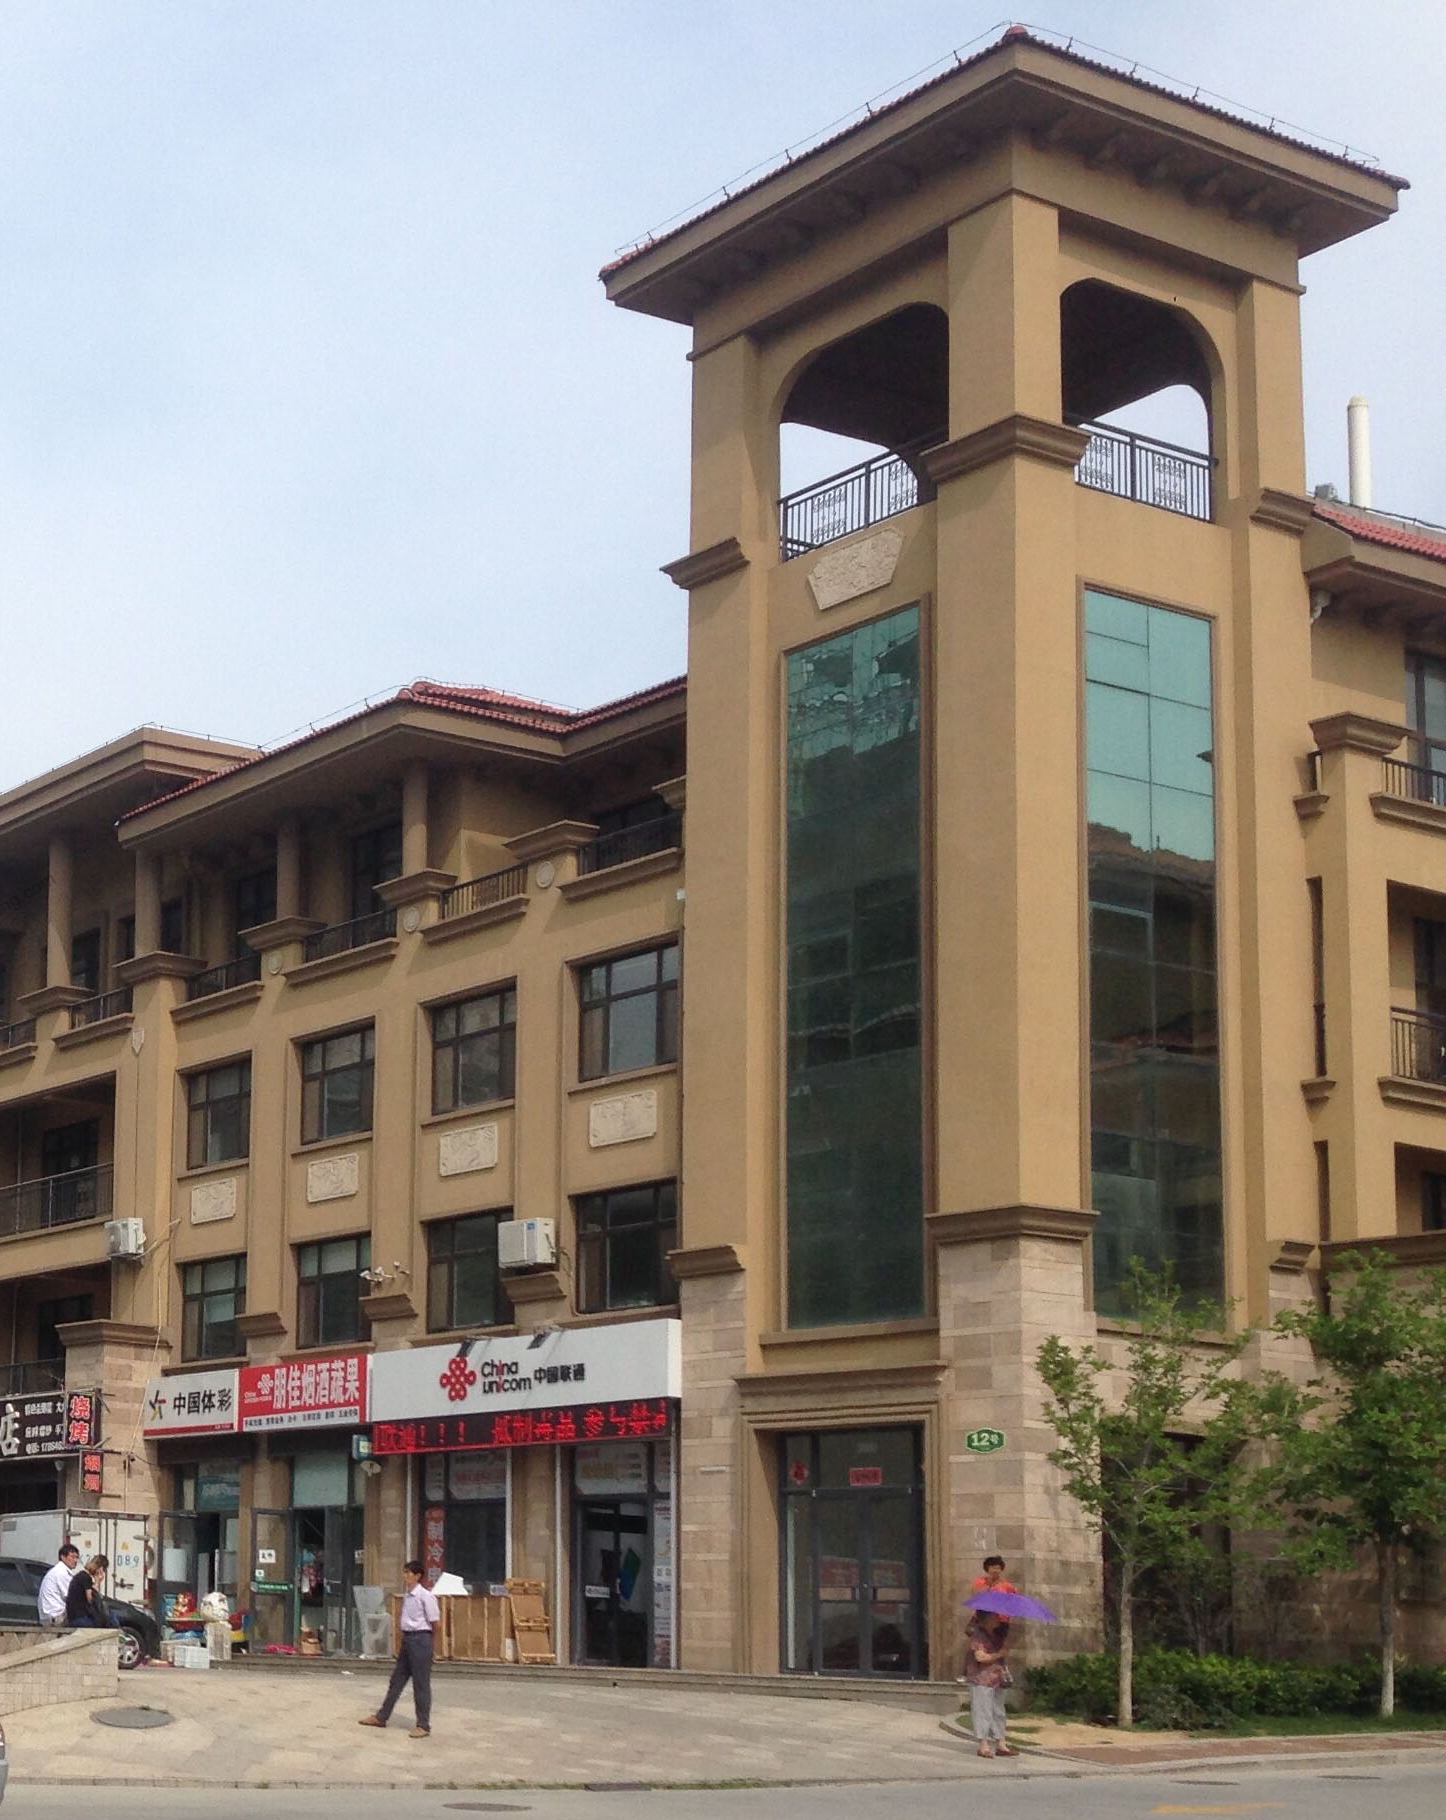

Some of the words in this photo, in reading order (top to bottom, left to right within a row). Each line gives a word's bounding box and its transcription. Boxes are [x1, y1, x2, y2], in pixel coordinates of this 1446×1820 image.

[481, 1360, 519, 1377] China
[534, 1363, 585, 1384] 中国联通
[273, 1358, 360, 1410] 朋佳烟酒蔬果
[482, 1375, 532, 1394] unicom
[173, 1388, 232, 1416] 中国体彩
[69, 1396, 91, 1445] 烧烤
